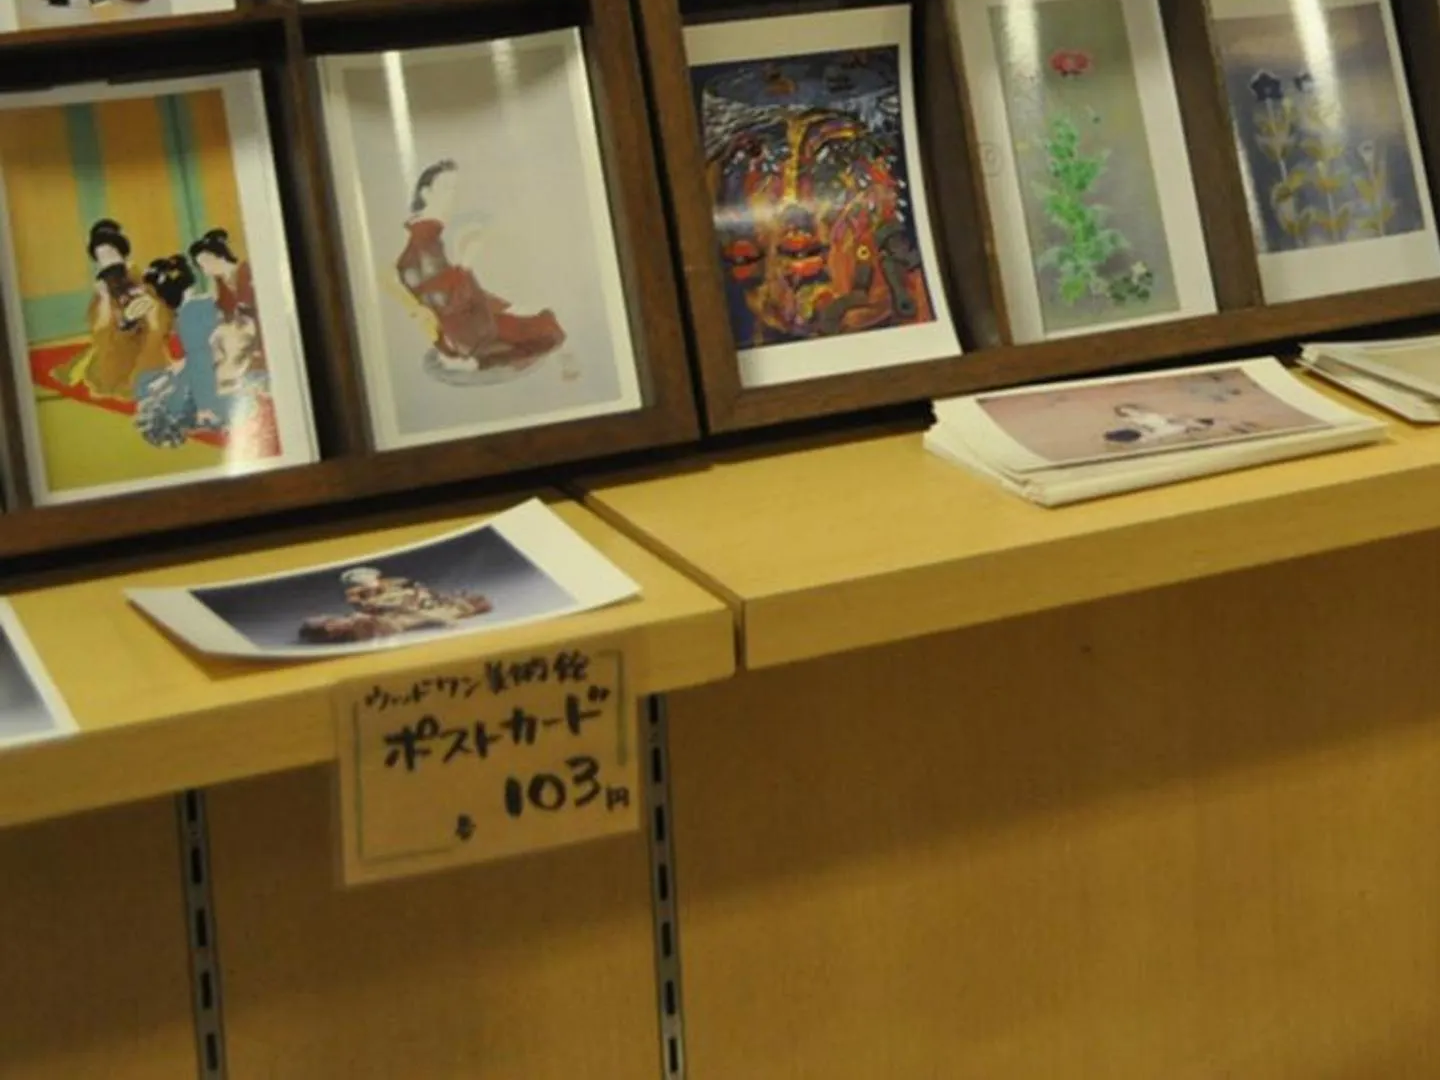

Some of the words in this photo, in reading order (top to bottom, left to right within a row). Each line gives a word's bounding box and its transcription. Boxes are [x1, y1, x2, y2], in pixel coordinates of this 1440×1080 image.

[383, 685, 611, 772] ポストカード
[504, 754, 631, 818] 103円
